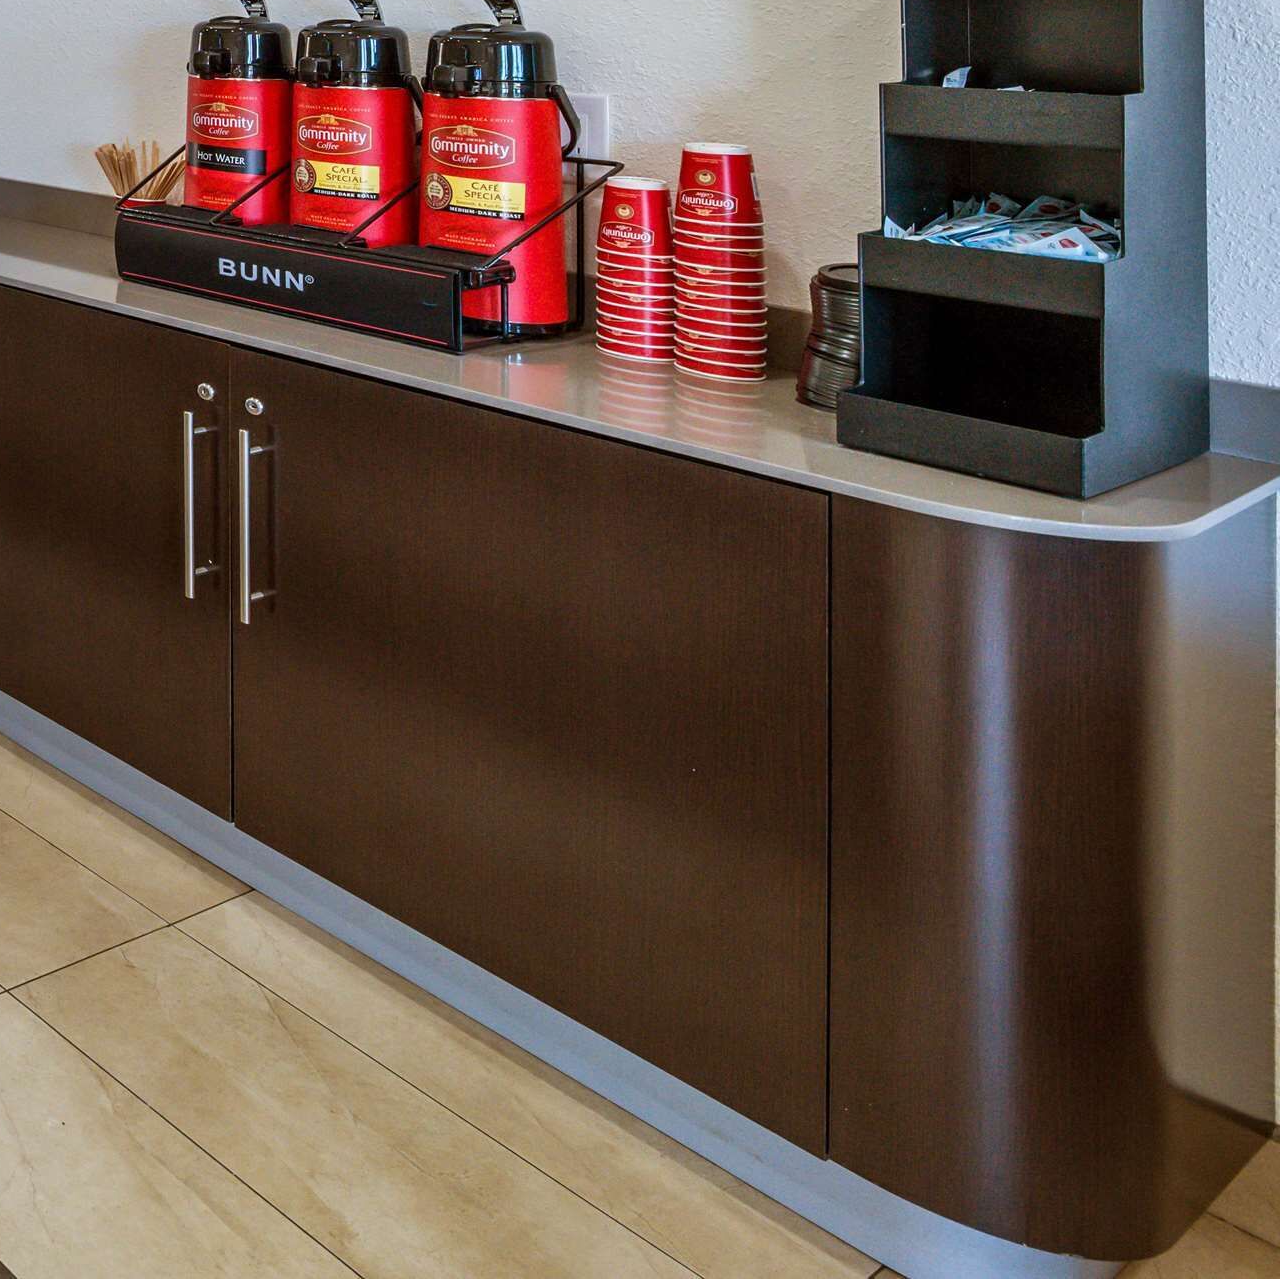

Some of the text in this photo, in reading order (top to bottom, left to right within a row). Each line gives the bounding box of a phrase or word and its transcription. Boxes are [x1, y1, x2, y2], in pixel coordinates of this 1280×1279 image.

[193, 112, 254, 131] Community
[209, 127, 229, 135] Coffee
[299, 125, 367, 145] Community
[316, 141, 340, 150] Coffee
[431, 136, 510, 159] Community
[215, 153, 246, 165] WATER
[452, 153, 479, 164] Coffee
[331, 165, 356, 175] CAFÉ
[471, 182, 499, 192] CAFÉ
[681, 194, 735, 210] Community
[602, 226, 652, 243] Community
